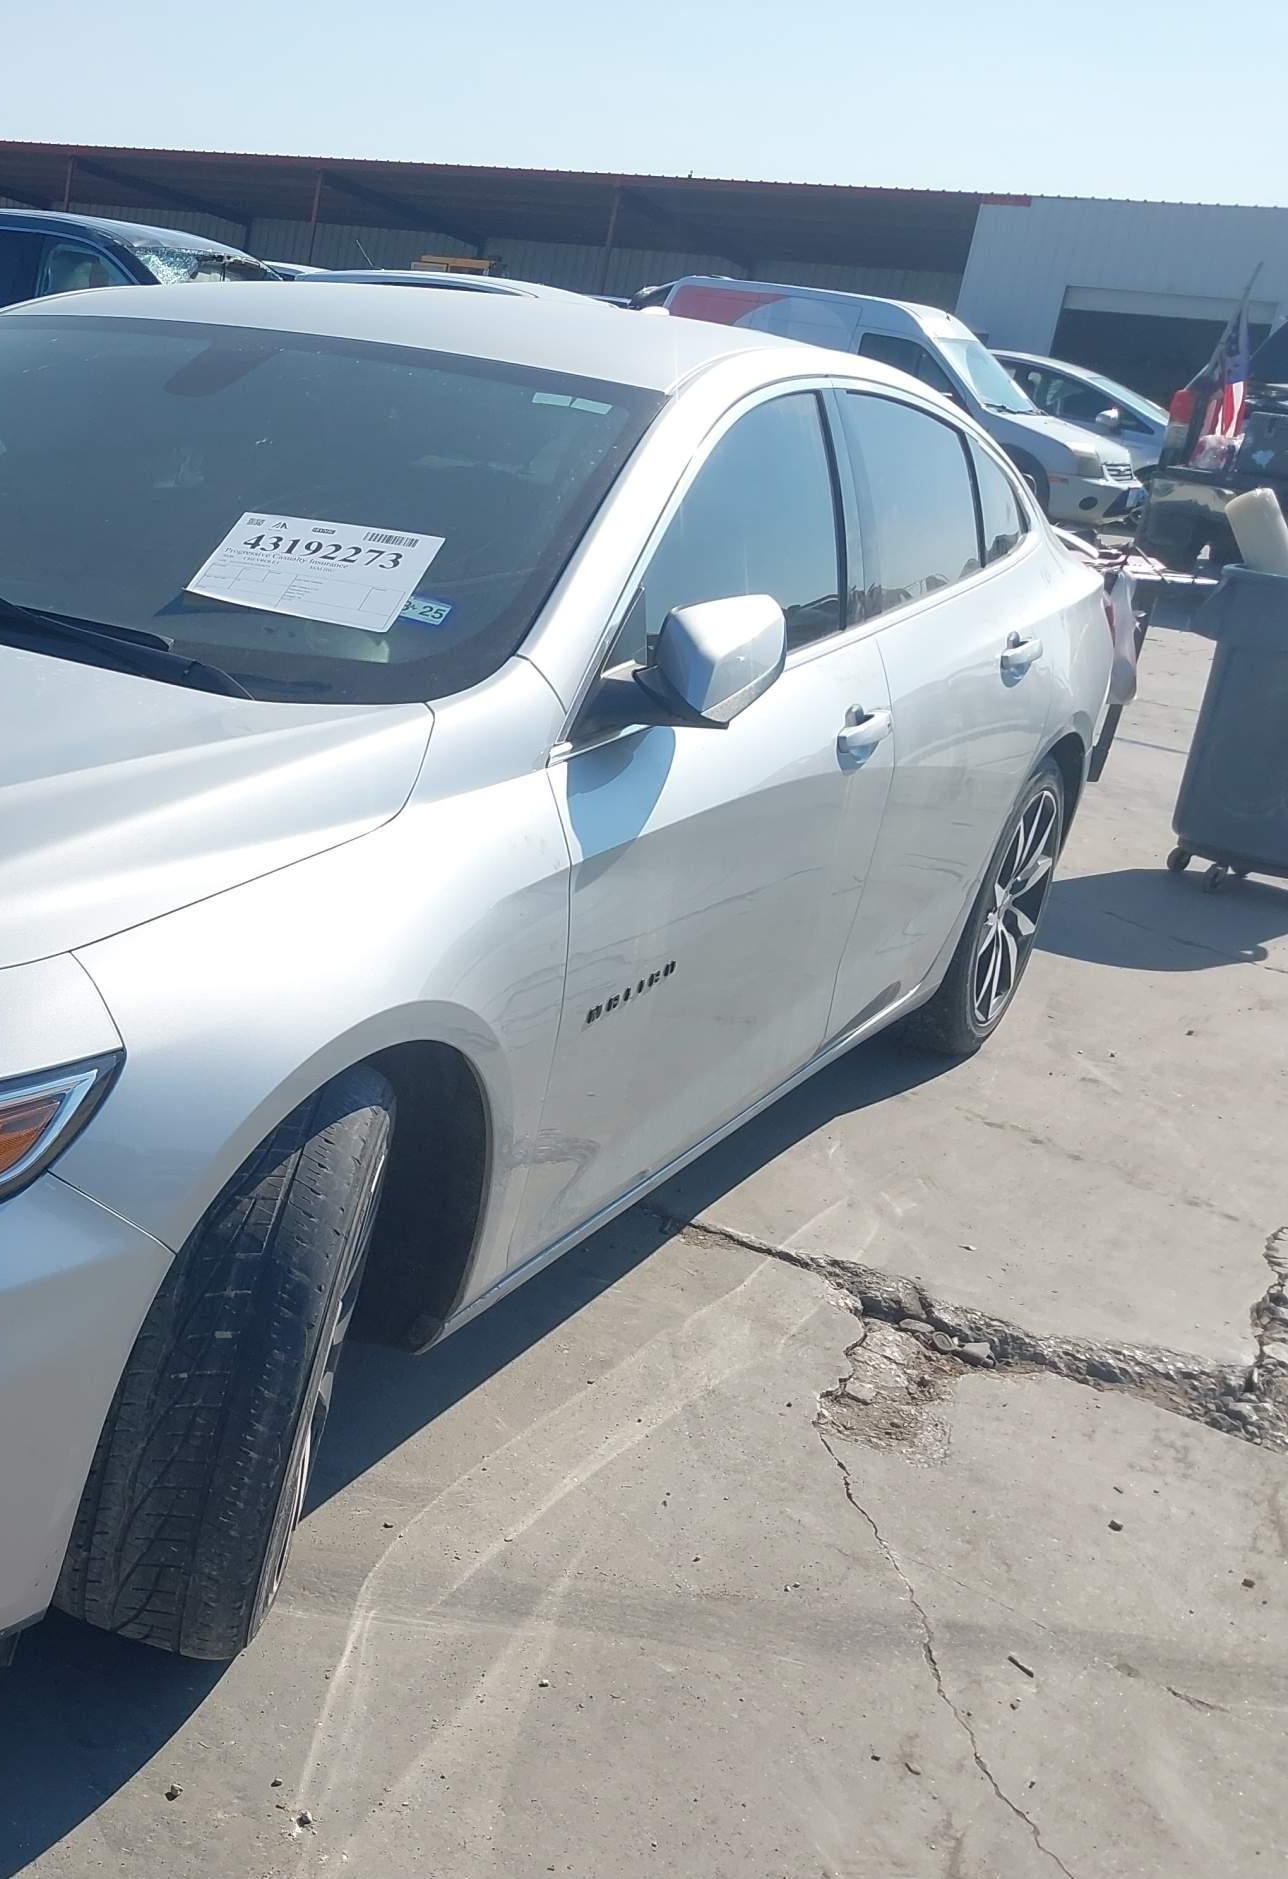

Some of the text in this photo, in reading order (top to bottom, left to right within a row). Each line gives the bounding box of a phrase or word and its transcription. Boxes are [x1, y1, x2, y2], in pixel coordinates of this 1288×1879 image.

[224, 547, 271, 559] Progressive
[309, 558, 349, 569] Insurance
[243, 534, 403, 569] 43192273
[418, 605, 446, 619] 25
